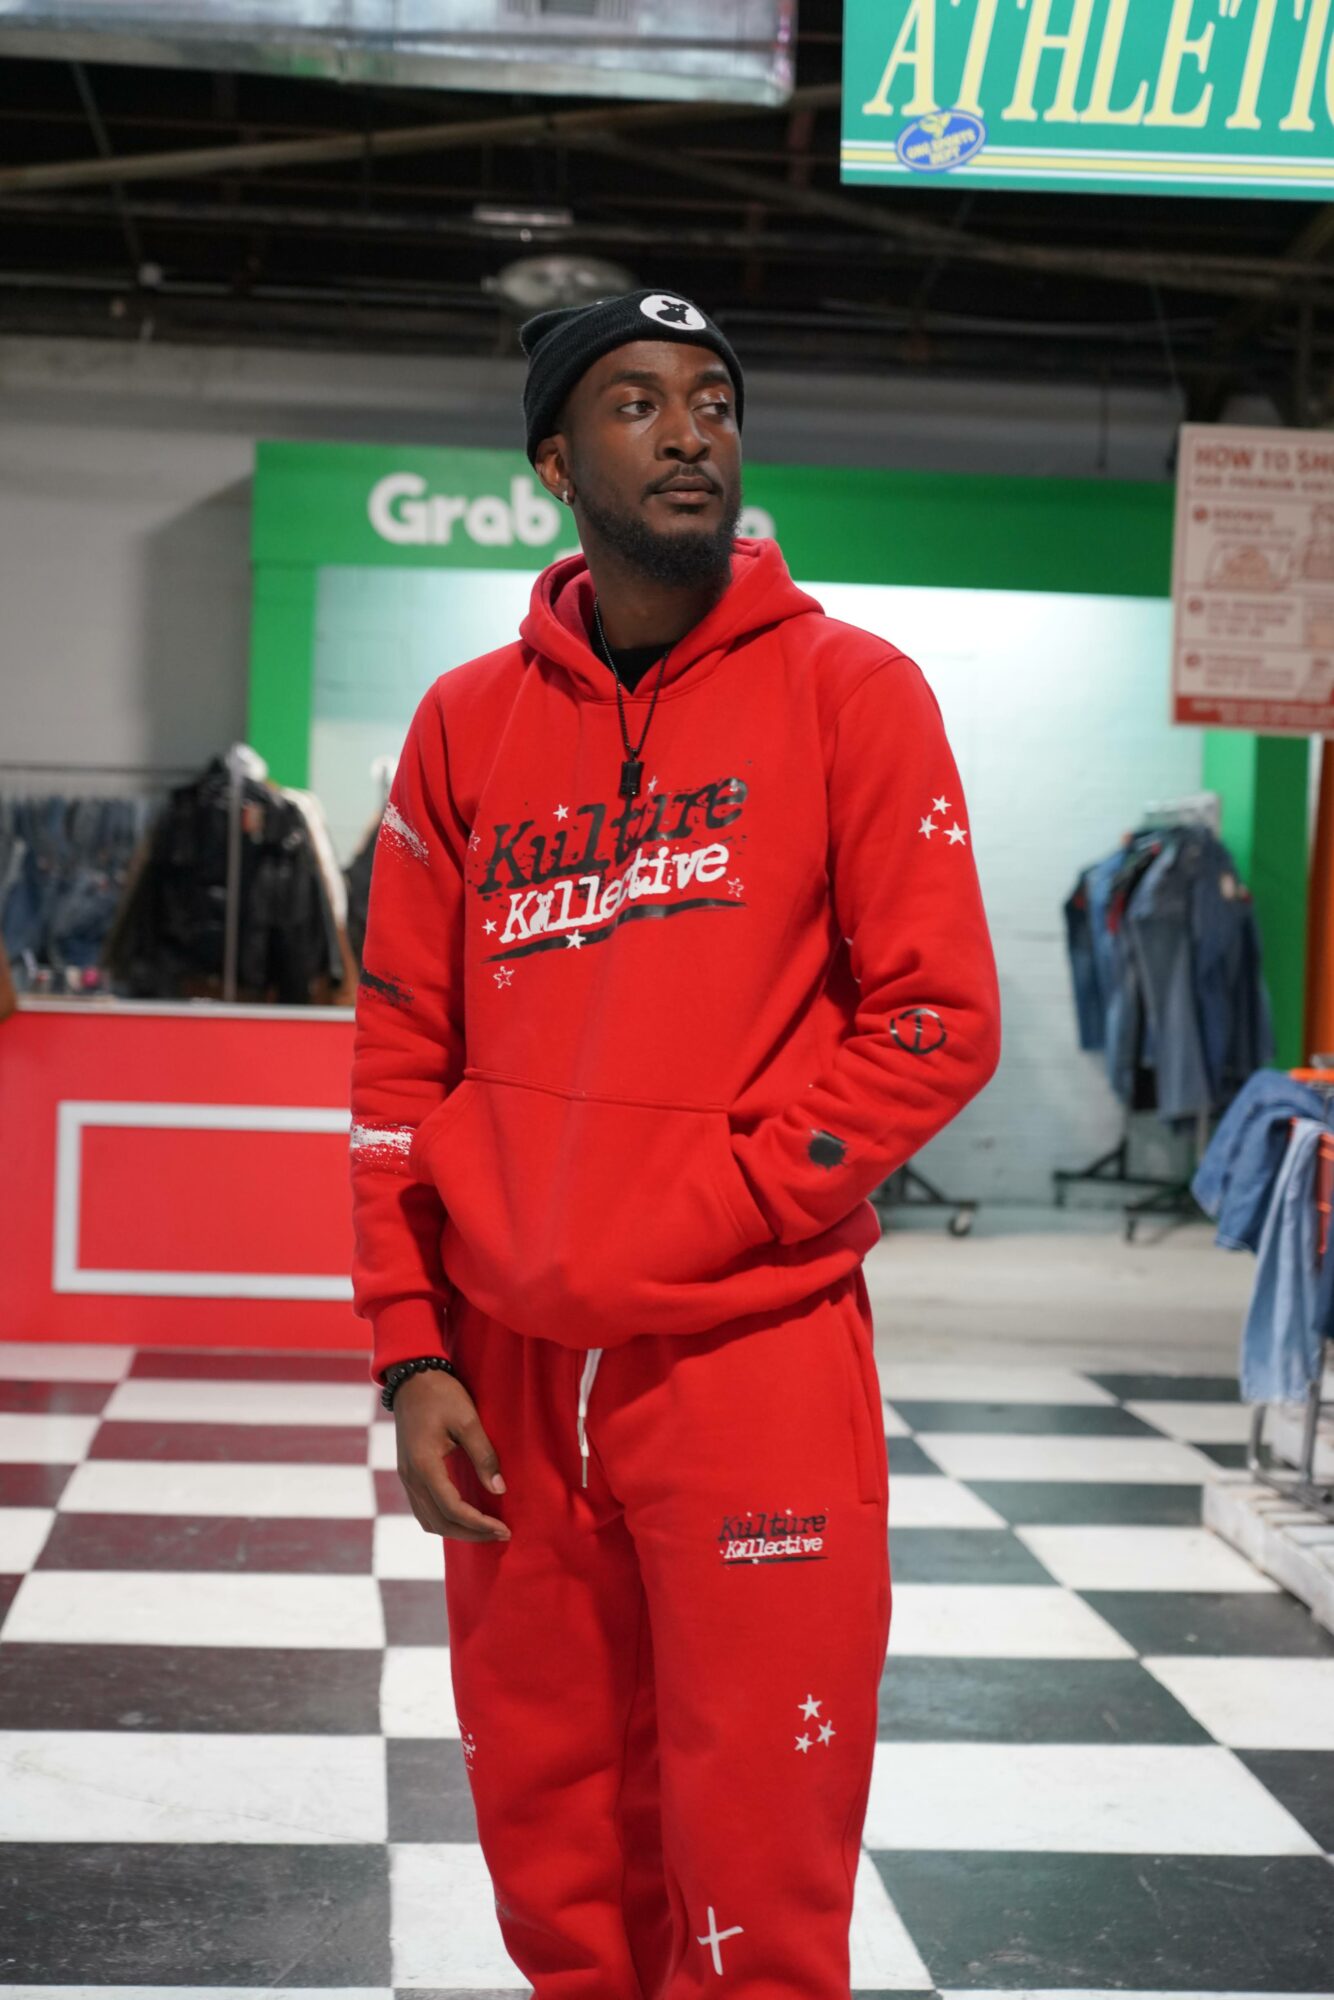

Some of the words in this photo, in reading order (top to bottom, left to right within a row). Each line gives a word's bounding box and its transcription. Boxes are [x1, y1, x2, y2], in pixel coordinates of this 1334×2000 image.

[862, 0, 1334, 131] ATHLETI
[1194, 445, 1254, 470] HOW
[1262, 448, 1291, 473] TO
[368, 472, 561, 547] Grab
[477, 777, 748, 895] Kulture
[718, 1512, 826, 1541] Kulture
